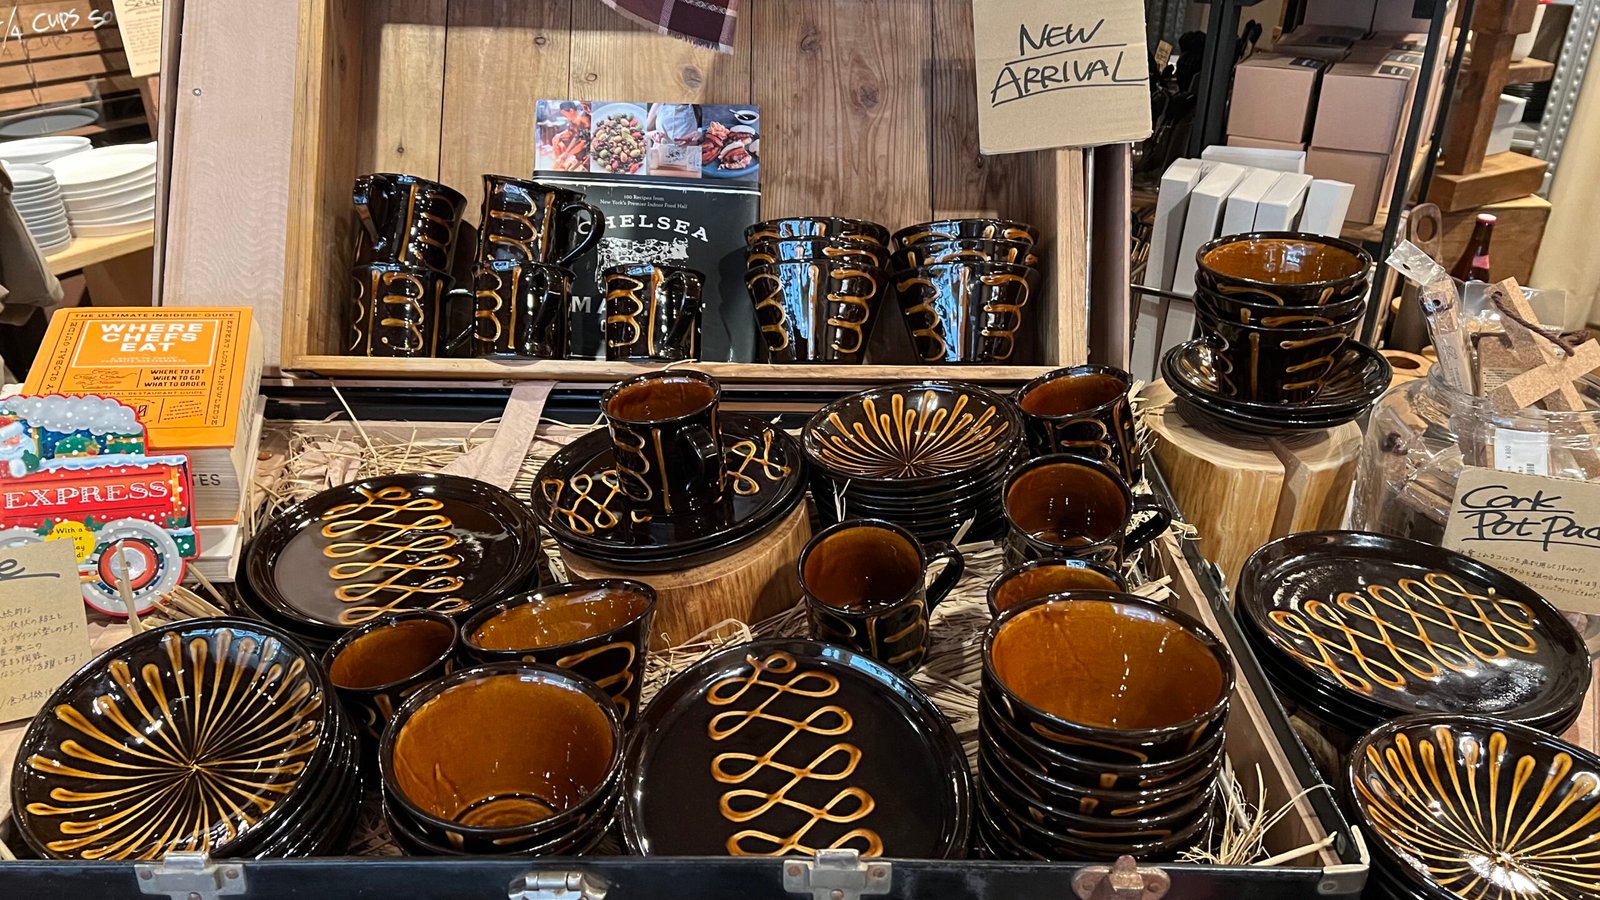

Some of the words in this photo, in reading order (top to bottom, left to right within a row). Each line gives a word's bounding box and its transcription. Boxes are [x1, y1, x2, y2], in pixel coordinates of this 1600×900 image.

[1019, 18, 1105, 56] NEW
[990, 50, 1149, 104] ARRIVAL
[101, 323, 204, 333] WHERE
[101, 332, 198, 343] CHEFS
[120, 342, 176, 352] EAT
[3, 480, 169, 510] EXPRESS
[1460, 485, 1562, 511] Cork
[1464, 511, 1542, 540] Pot
